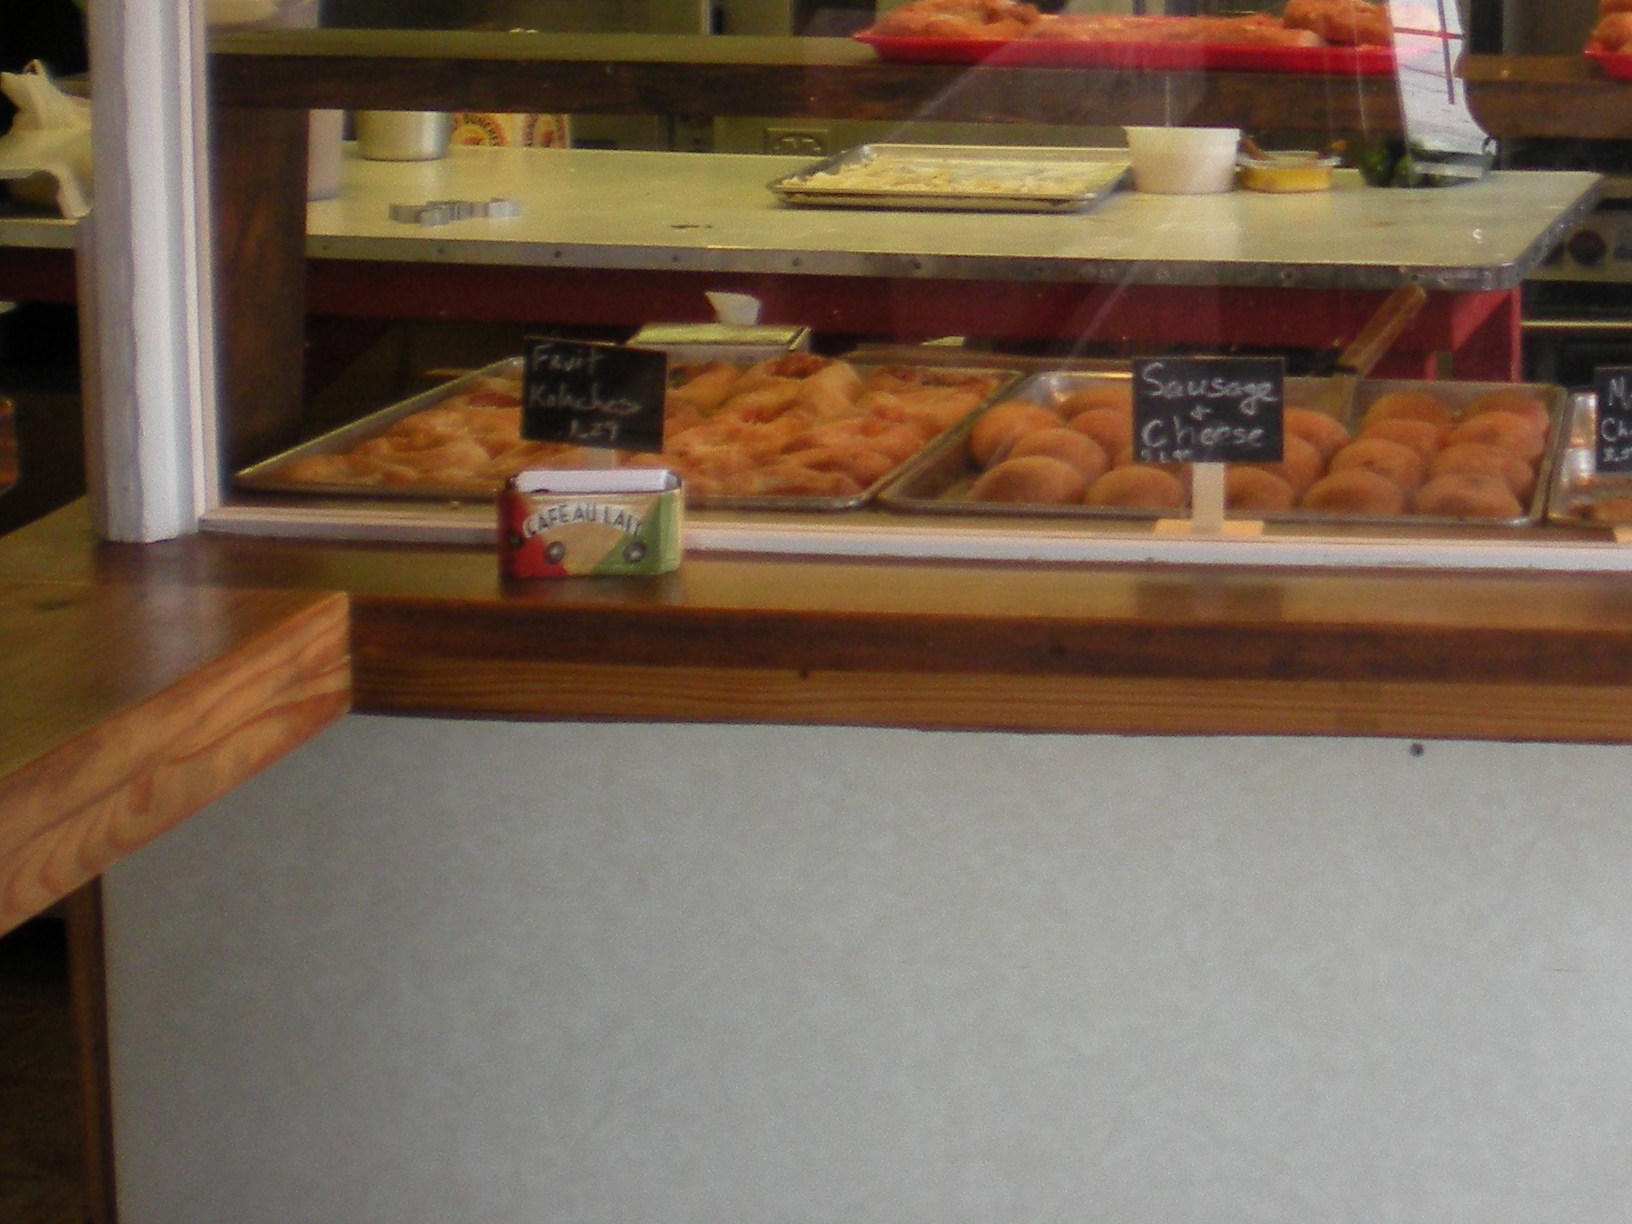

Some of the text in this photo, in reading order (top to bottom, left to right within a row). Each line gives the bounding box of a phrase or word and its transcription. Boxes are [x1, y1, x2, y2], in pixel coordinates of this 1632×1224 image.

[1141, 361, 1279, 416] Sausage
[1141, 415, 1265, 448] Cheese
[572, 502, 597, 522] AU
